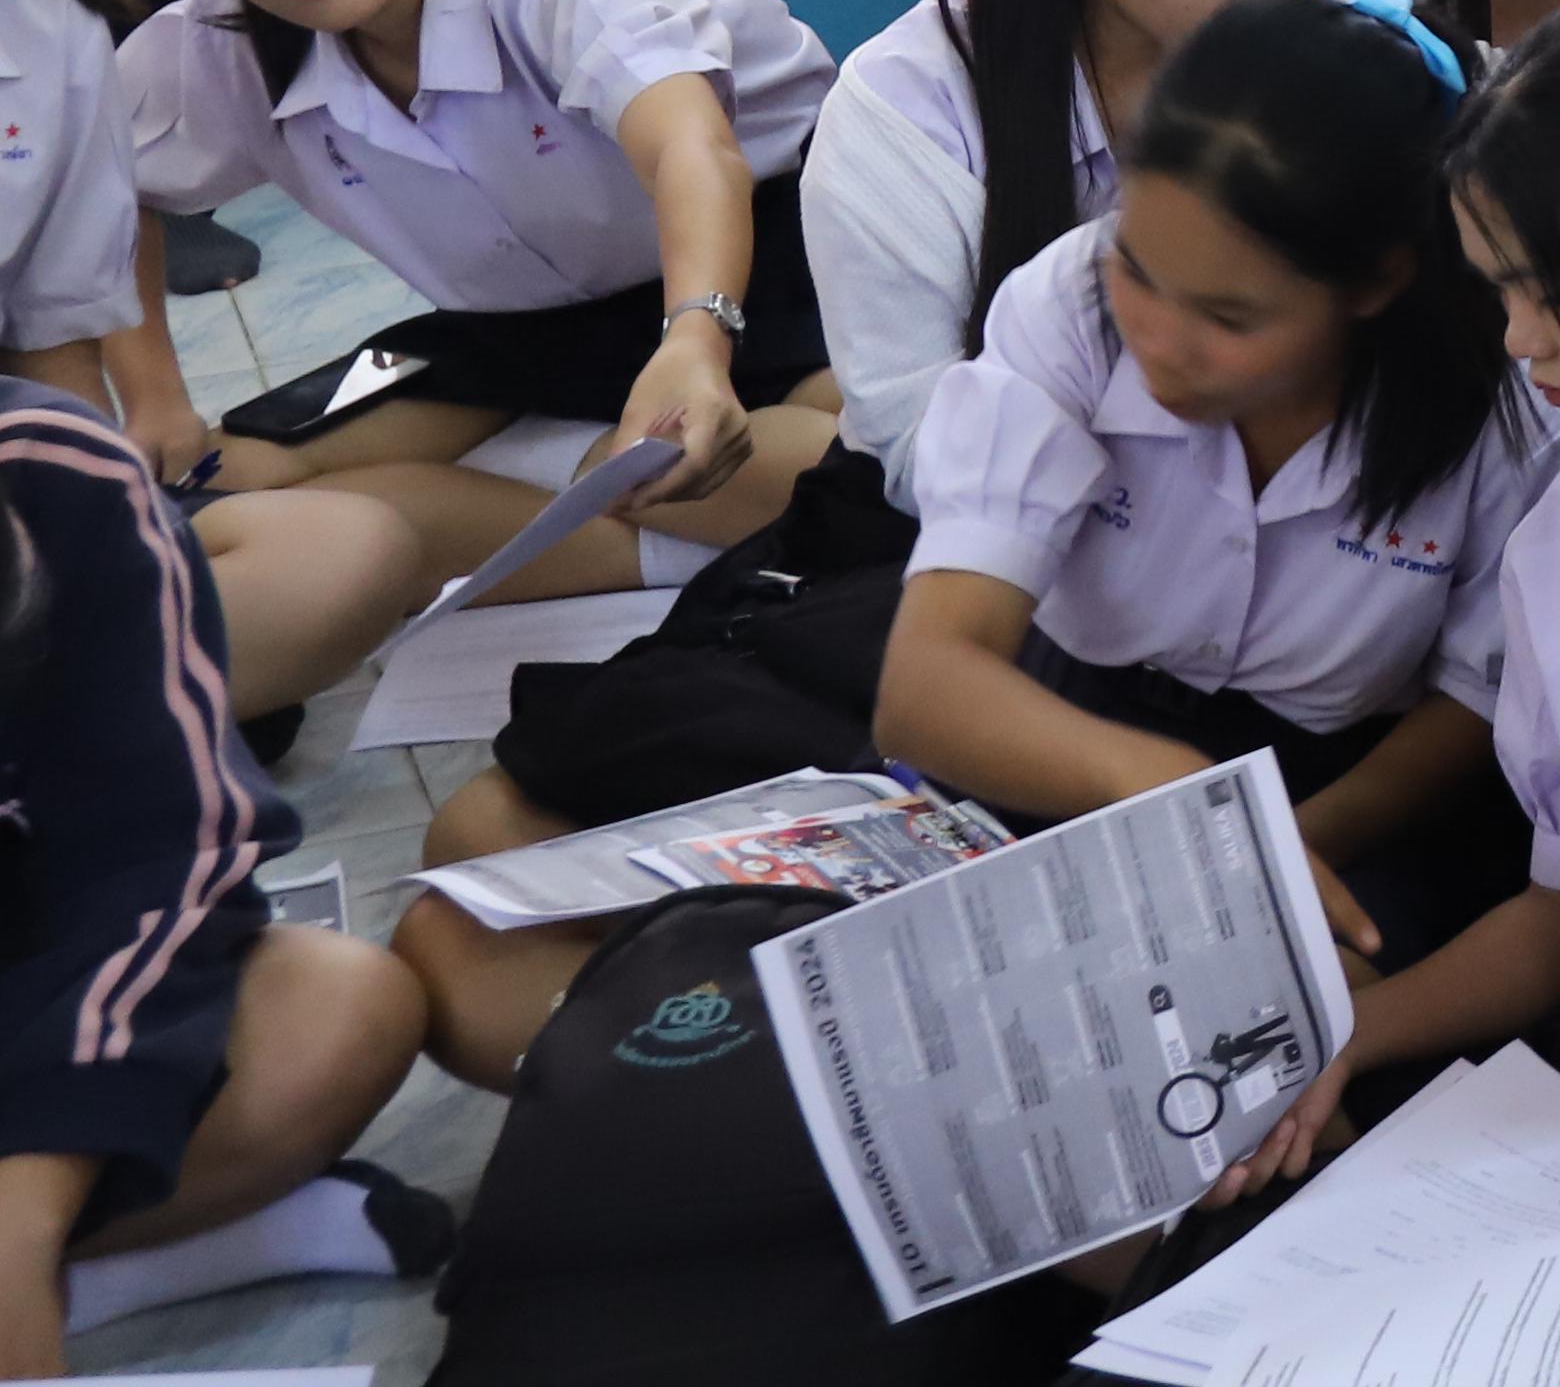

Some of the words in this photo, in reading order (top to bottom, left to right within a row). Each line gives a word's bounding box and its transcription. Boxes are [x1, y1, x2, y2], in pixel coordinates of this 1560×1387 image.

[792, 936, 834, 1013] 2024
[816, 1018, 910, 1237] เทรนด์อาชีพมาแรงปี
[898, 1241, 929, 1278] 10
